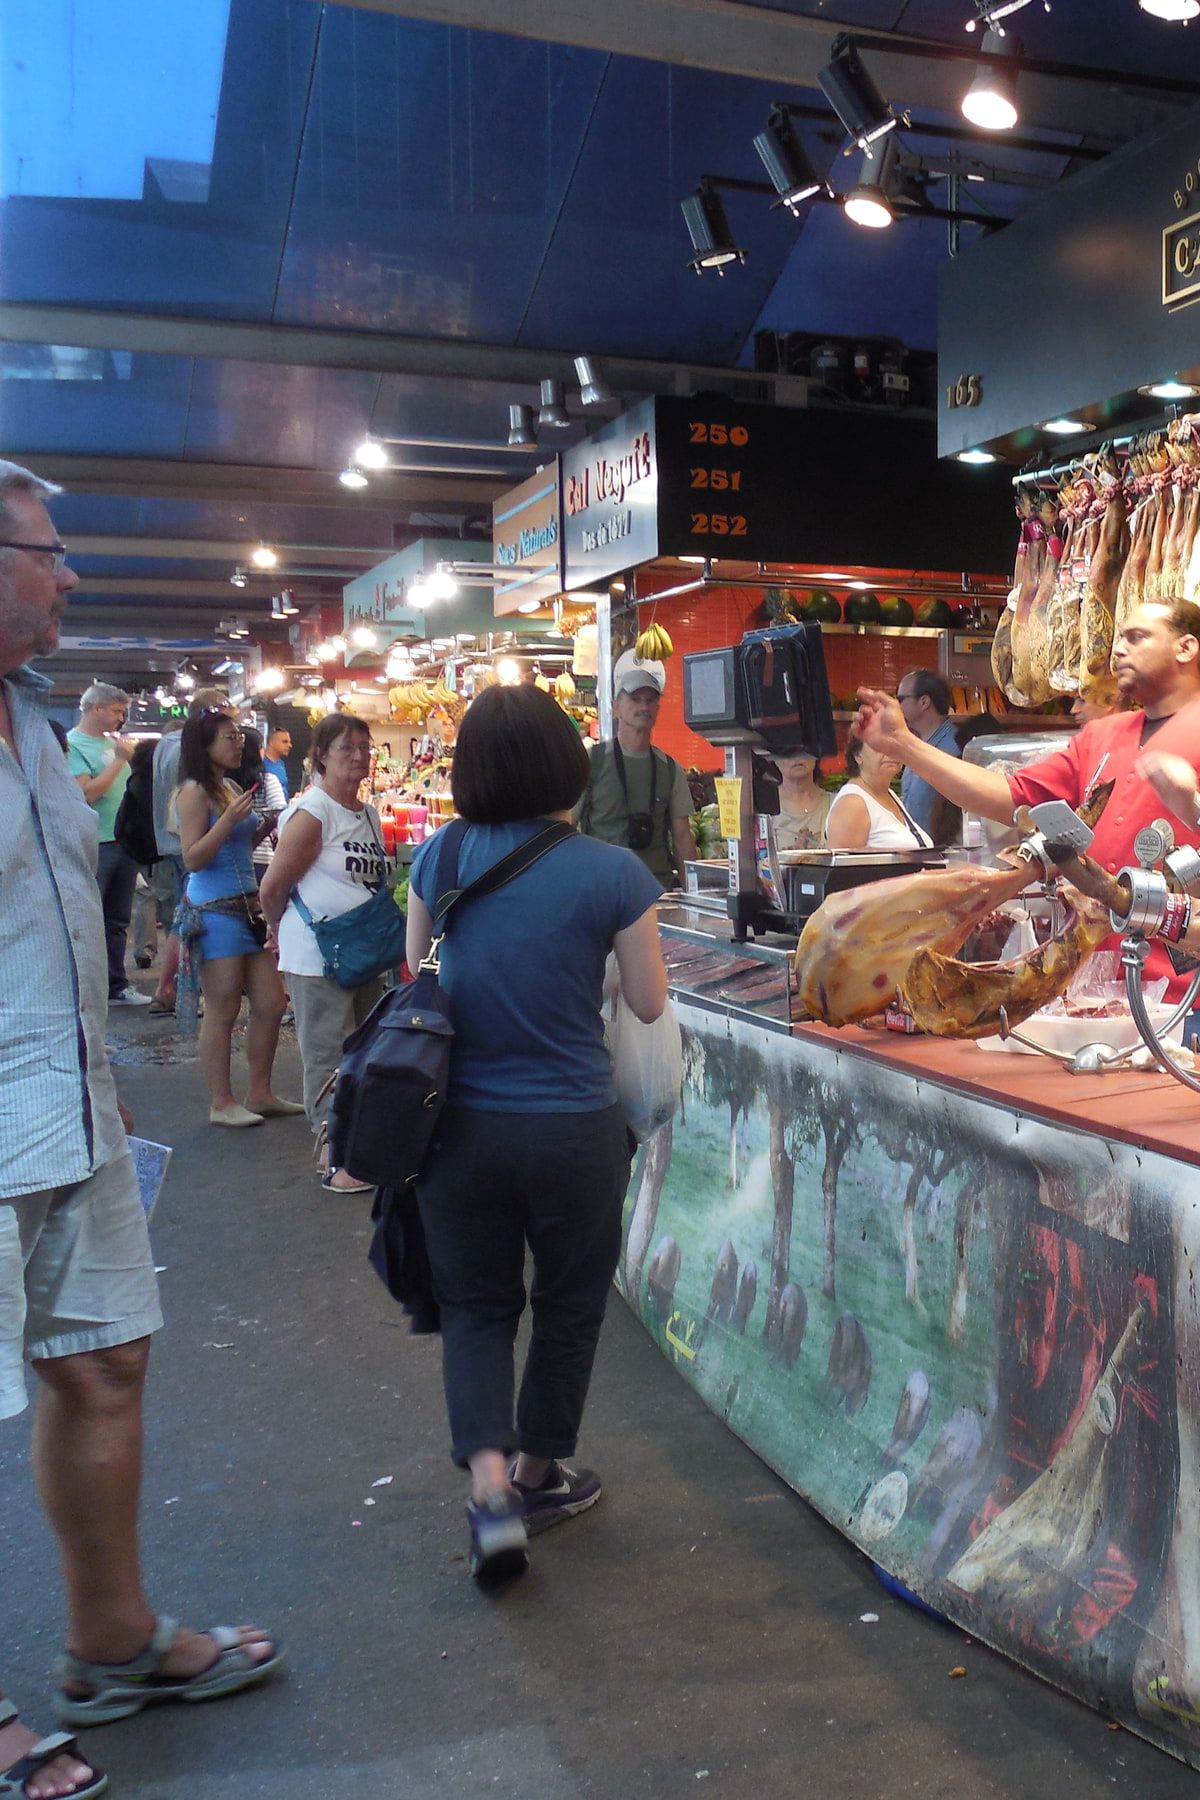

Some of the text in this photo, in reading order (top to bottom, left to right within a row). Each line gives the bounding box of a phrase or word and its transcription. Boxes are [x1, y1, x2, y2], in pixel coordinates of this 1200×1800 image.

[946, 373, 979, 409] 165
[690, 422, 749, 446] 250
[690, 468, 740, 490] 251
[691, 513, 748, 535] 252
